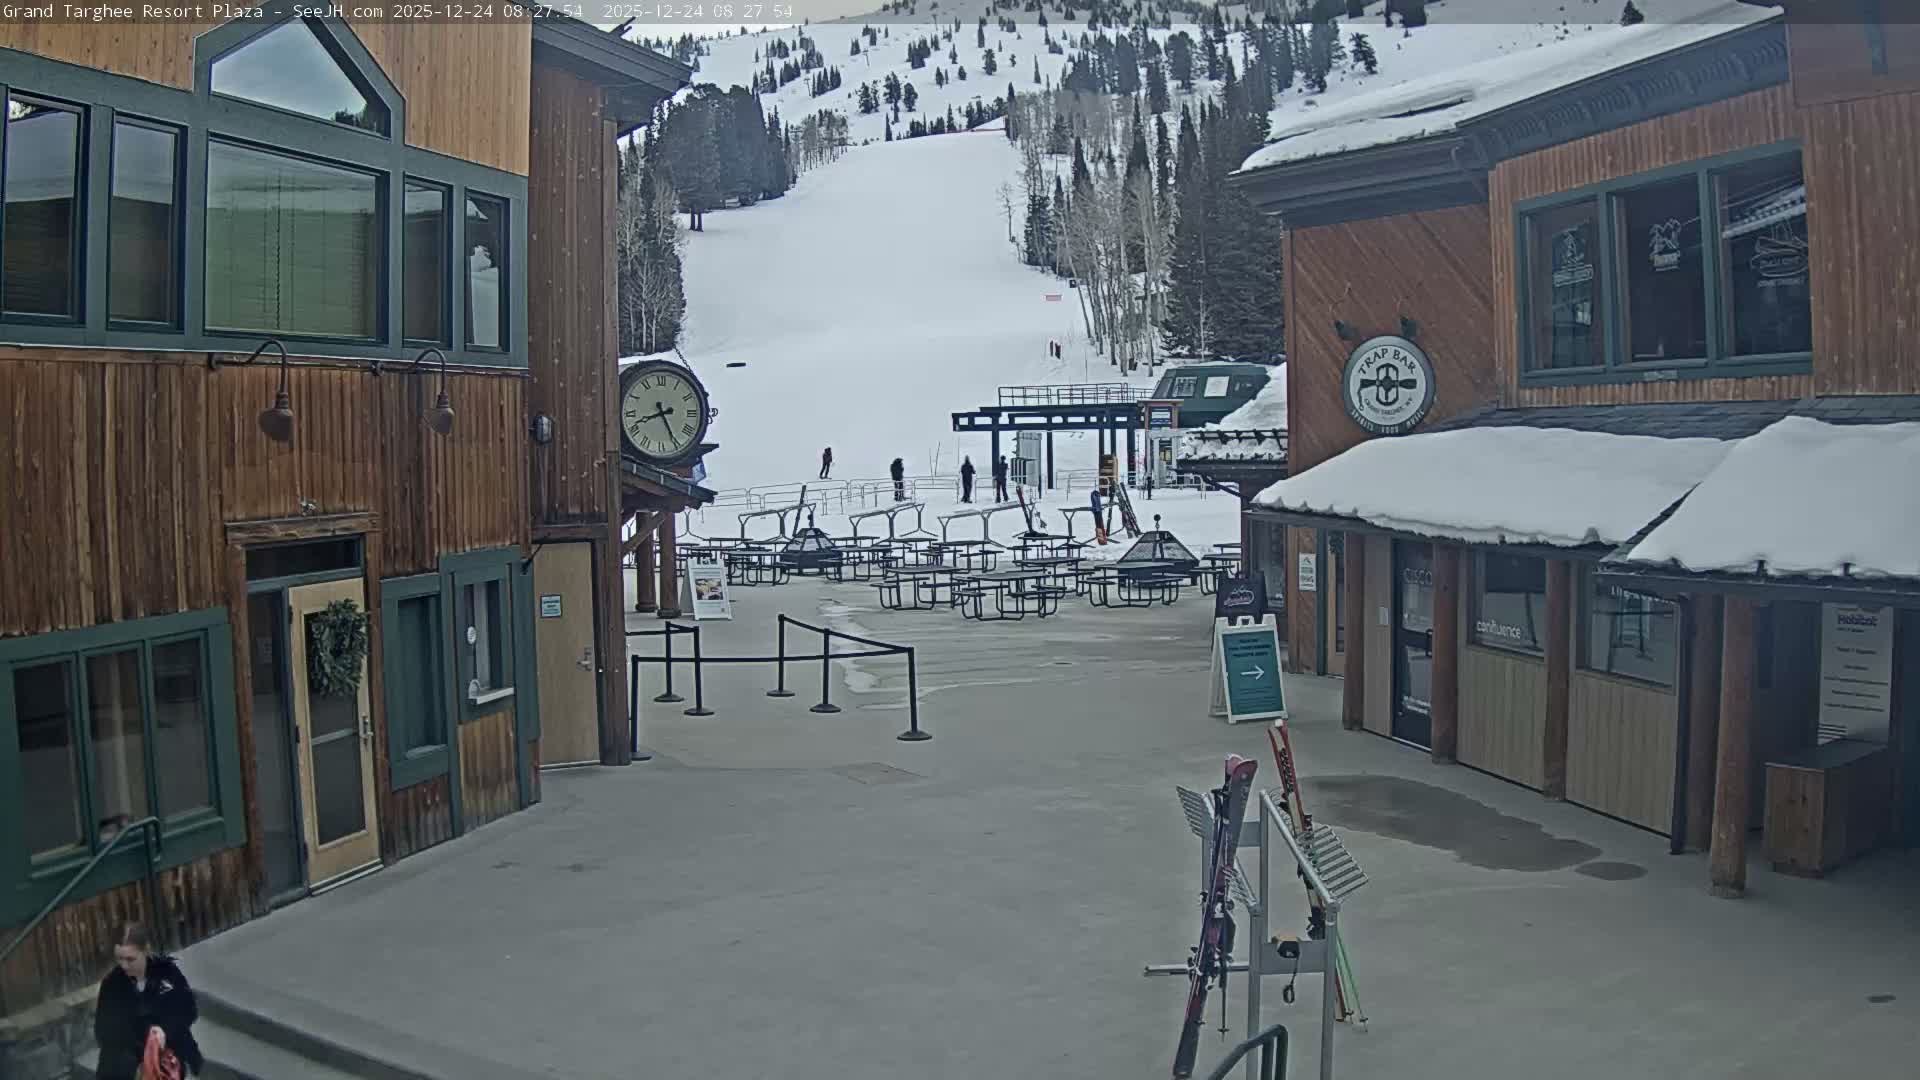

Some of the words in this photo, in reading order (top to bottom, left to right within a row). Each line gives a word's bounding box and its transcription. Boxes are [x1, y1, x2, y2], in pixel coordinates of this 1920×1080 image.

[1359, 348, 1388, 374] TRAP
[1393, 349, 1416, 374] BAR
[1476, 619, 1521, 639] confluence
